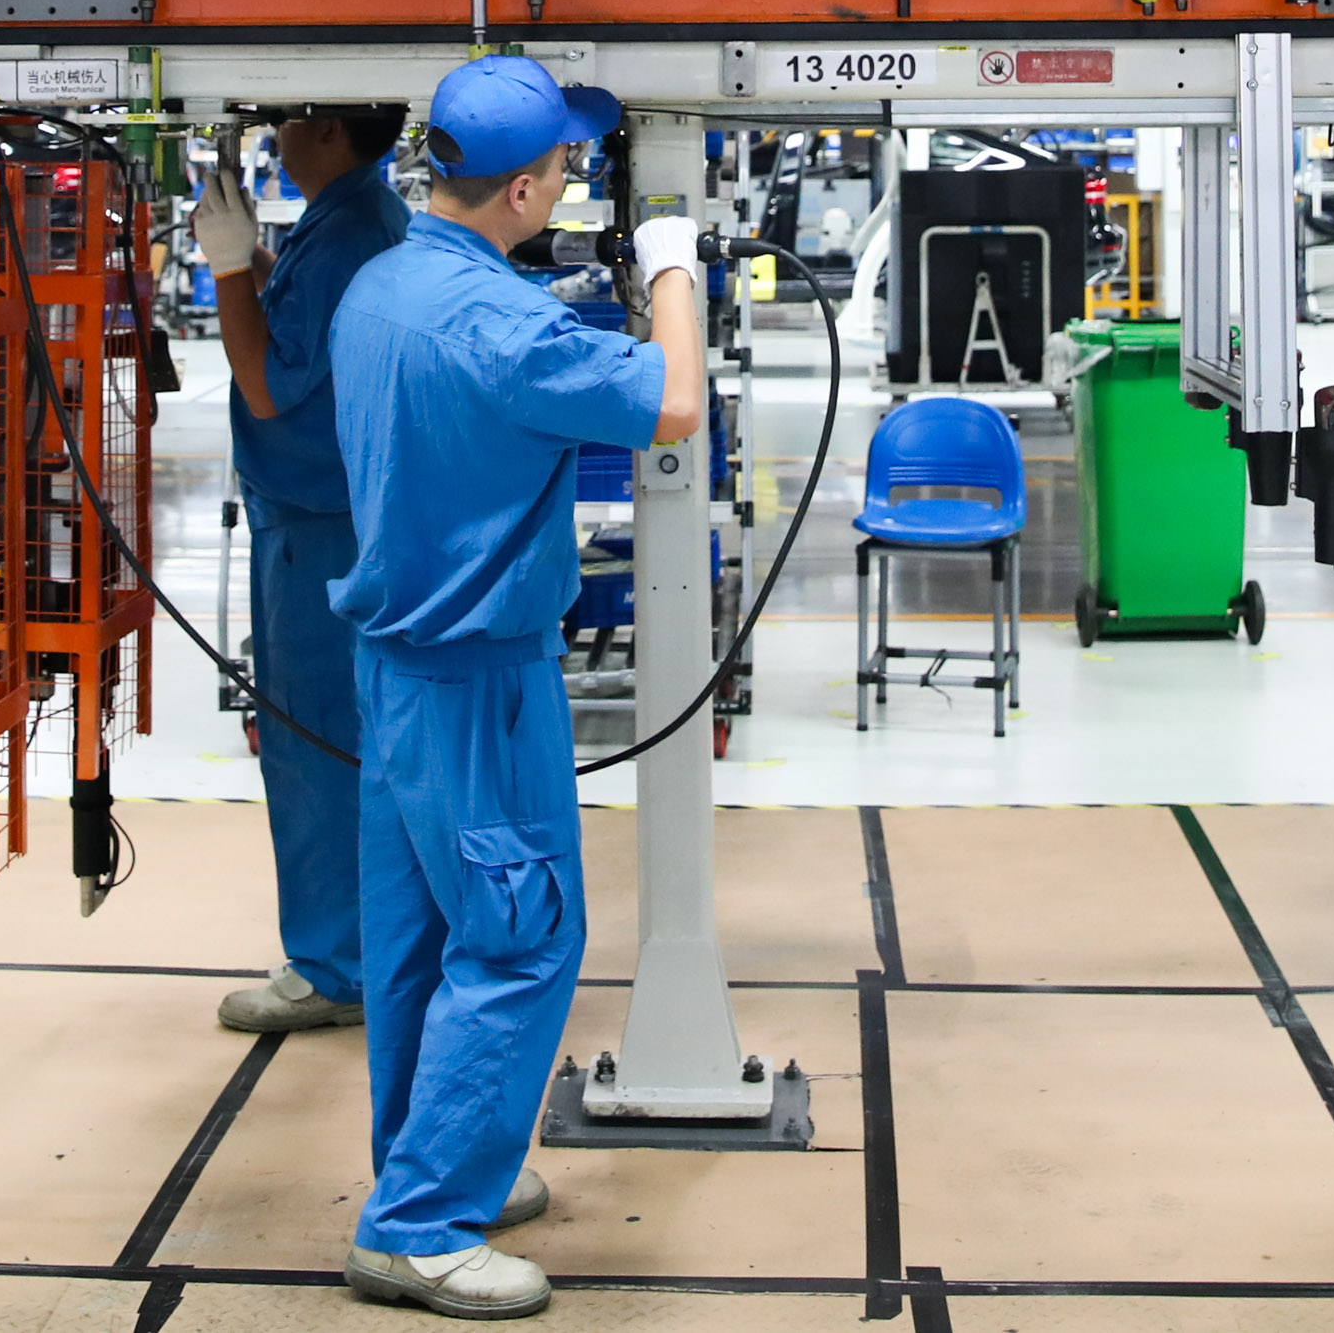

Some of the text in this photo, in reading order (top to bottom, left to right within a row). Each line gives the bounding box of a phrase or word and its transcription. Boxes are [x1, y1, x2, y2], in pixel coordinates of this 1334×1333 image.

[786, 53, 916, 83] 13 4020
[27, 69, 107, 84] 当心机械伤人
[29, 85, 105, 93] Caution Mechanical
